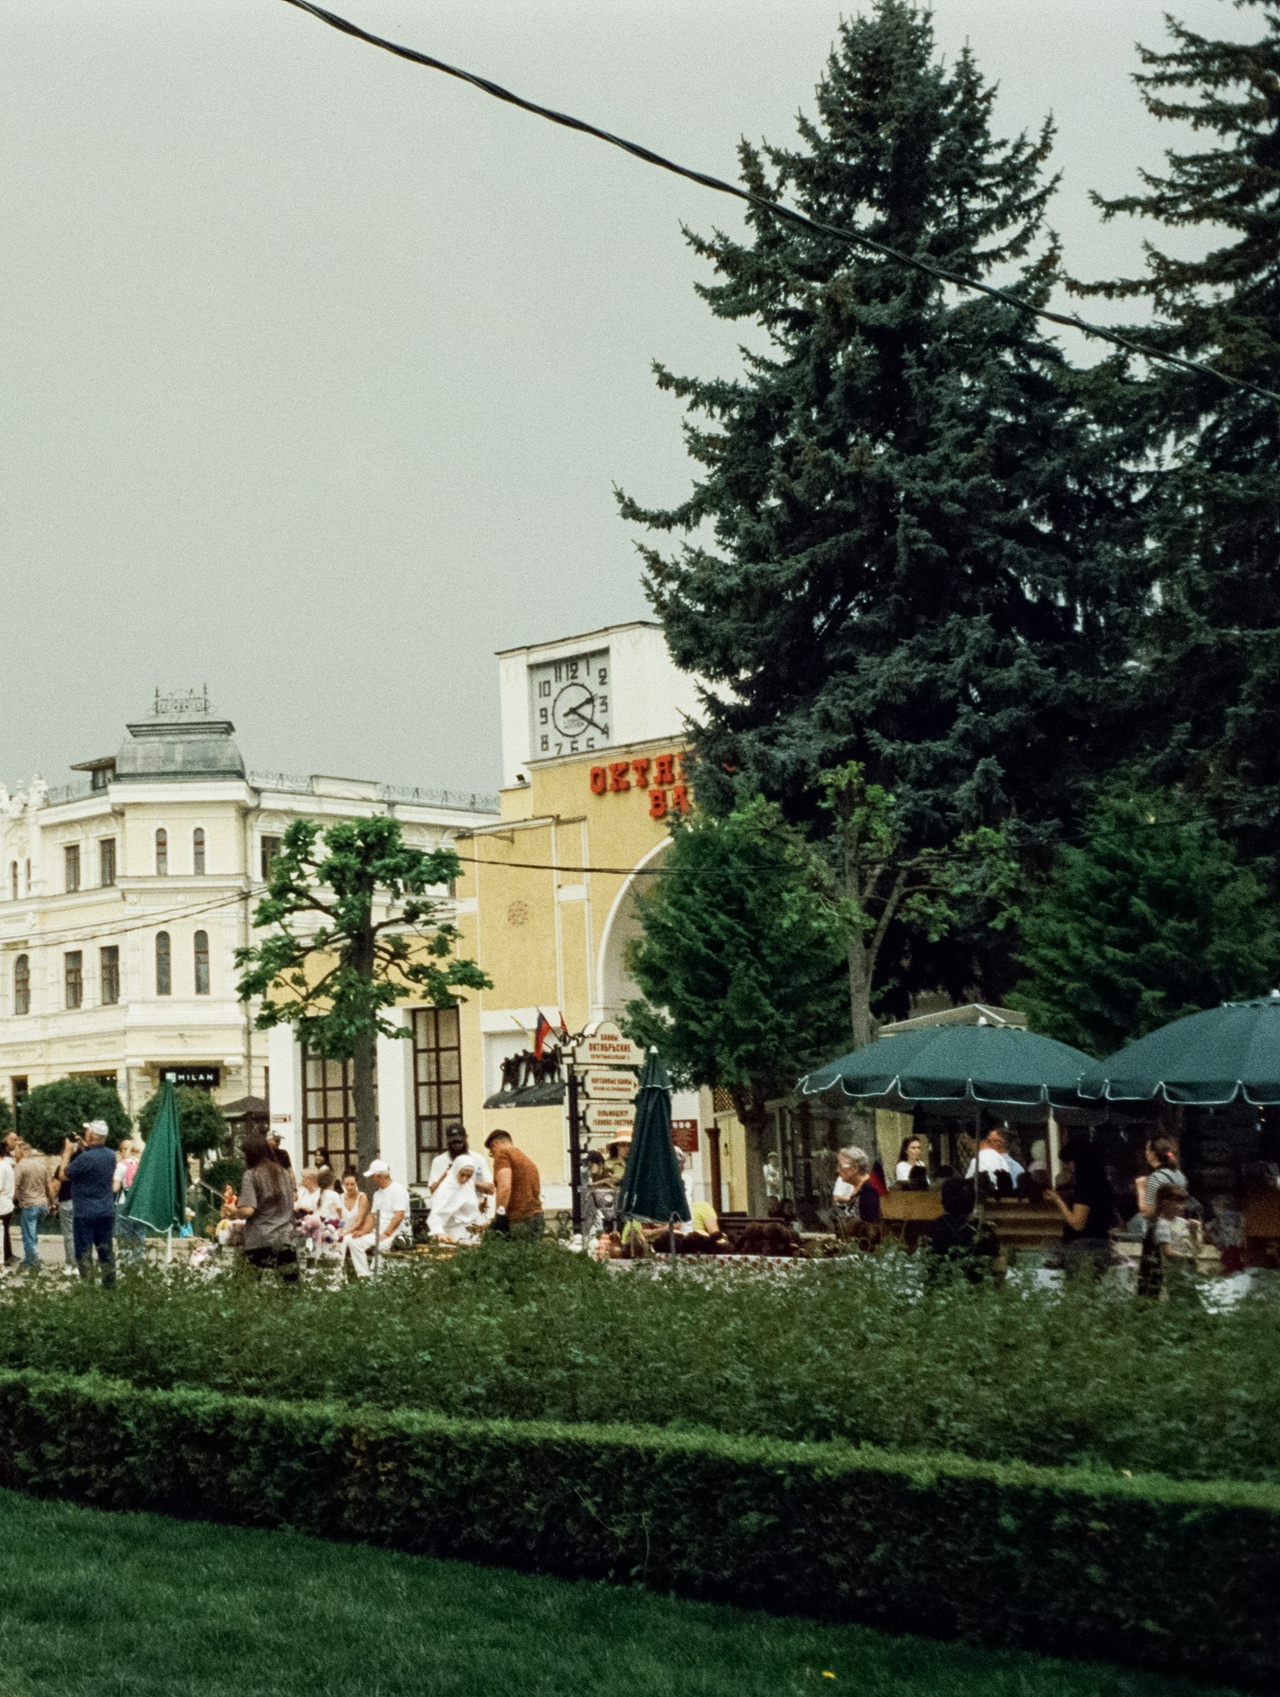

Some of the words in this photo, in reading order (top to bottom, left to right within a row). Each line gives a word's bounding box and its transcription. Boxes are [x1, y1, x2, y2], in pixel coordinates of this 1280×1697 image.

[566, 661, 579, 681] 12
[598, 667, 608, 686] 2
[539, 680, 551, 698] 10
[600, 695, 609, 713] 3
[539, 707, 548, 725] 9
[540, 734, 549, 752] 8
[555, 742, 563, 755] 7
[648, 785, 690, 820] ВА
[588, 1042, 631, 1052] ОКТЯБРЬСКИЕ
